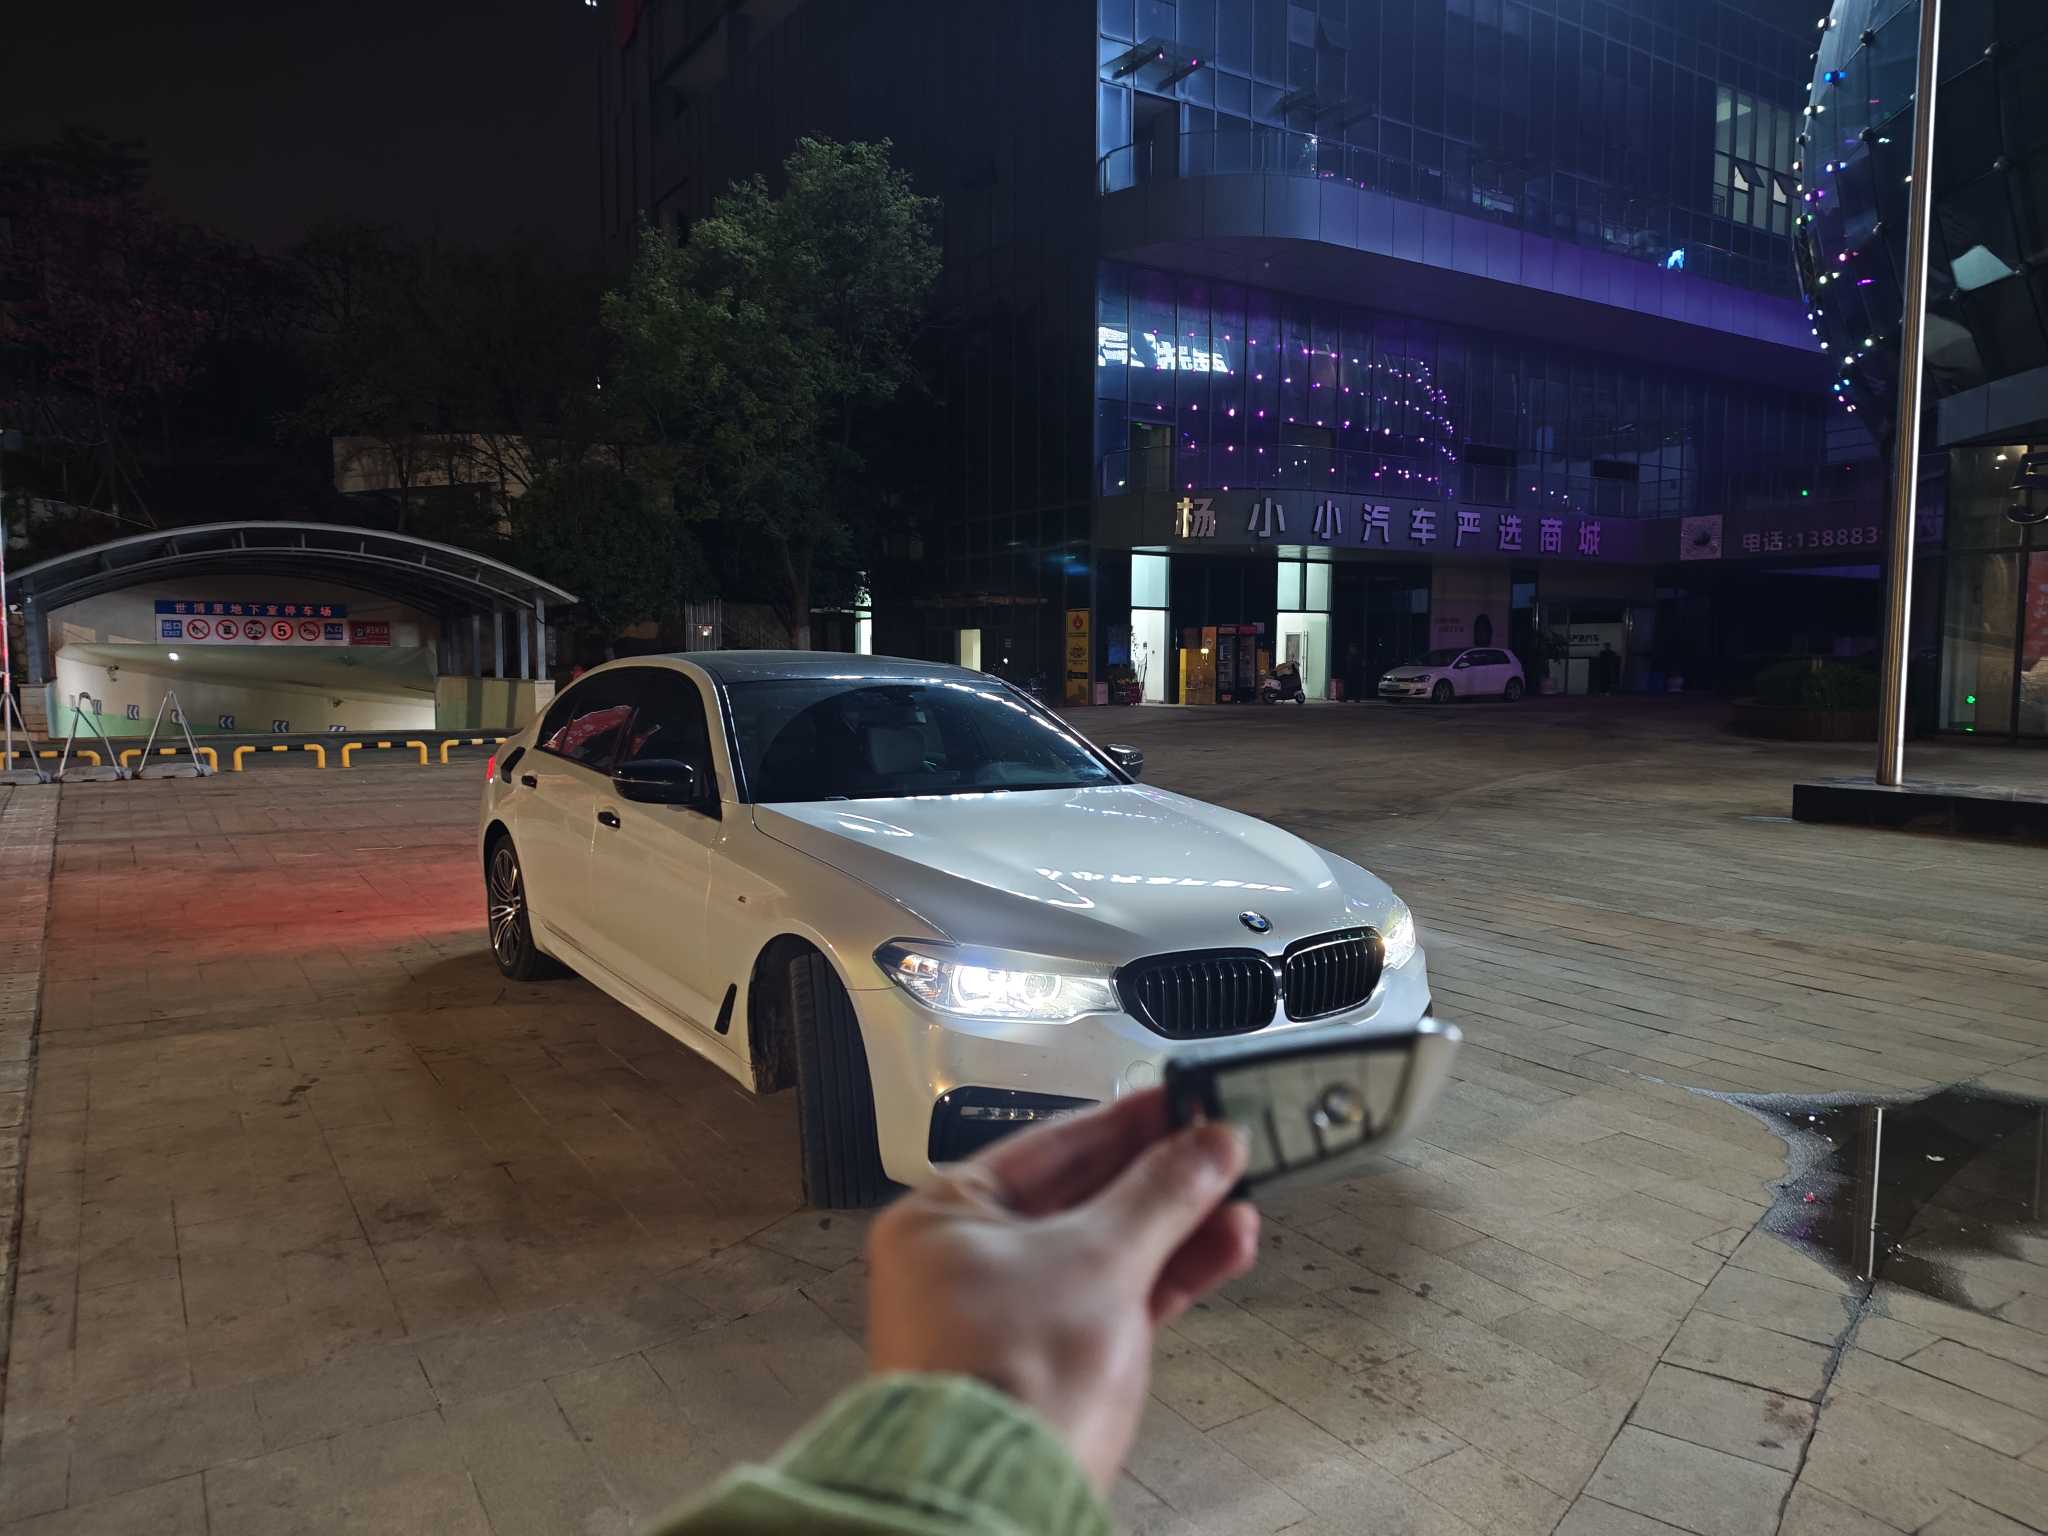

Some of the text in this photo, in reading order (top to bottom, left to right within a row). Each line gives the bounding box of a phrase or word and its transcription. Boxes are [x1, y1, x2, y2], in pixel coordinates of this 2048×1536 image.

[1174, 496, 1601, 555] 杨小小汽车严选商城
[1742, 526, 1881, 552] 电话:138883
[278, 625, 287, 637] 5
